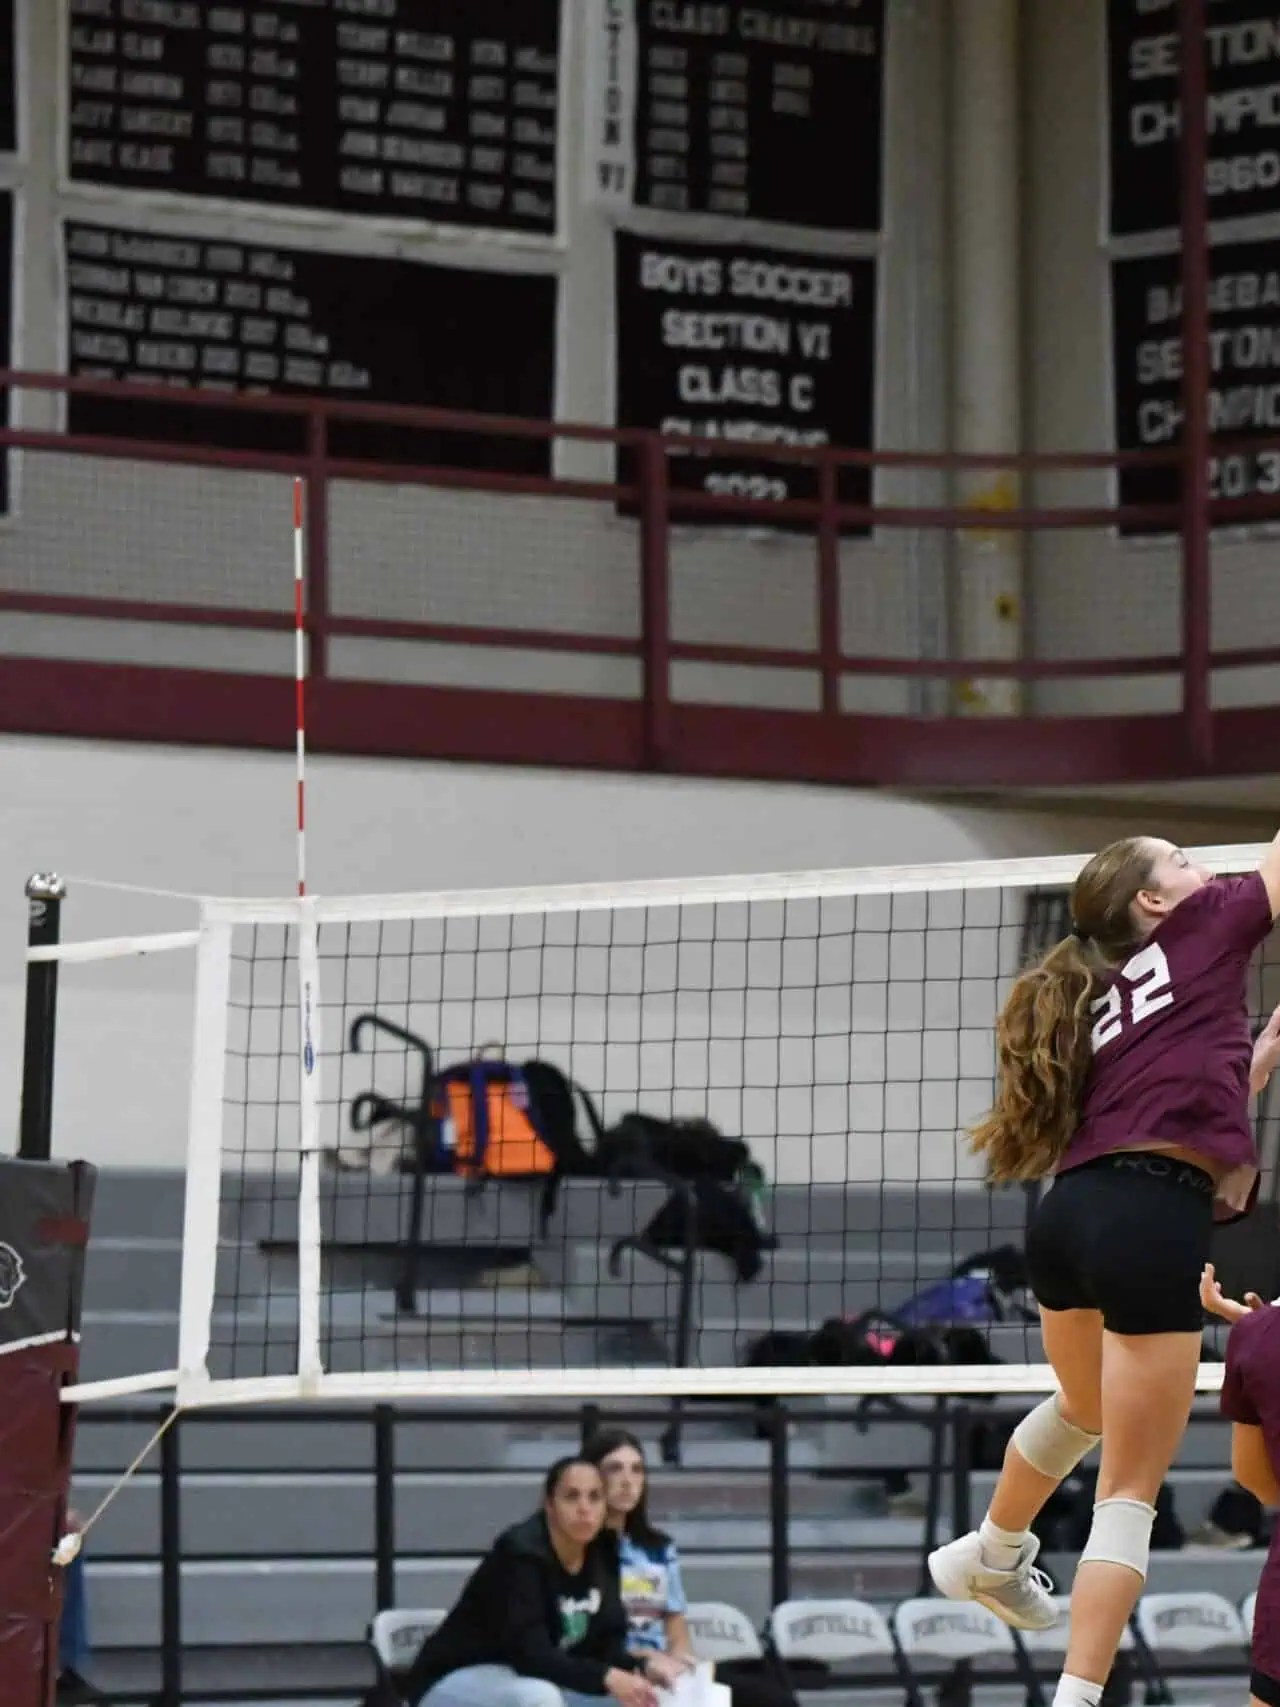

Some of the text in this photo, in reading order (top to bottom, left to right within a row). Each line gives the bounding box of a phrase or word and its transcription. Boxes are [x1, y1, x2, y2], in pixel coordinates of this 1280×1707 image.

[640, 251, 852, 307] BOYS SOCCER
[661, 308, 832, 360] SECTION VI
[678, 365, 814, 412] CLASS C
[1090, 941, 1174, 1053] 22
